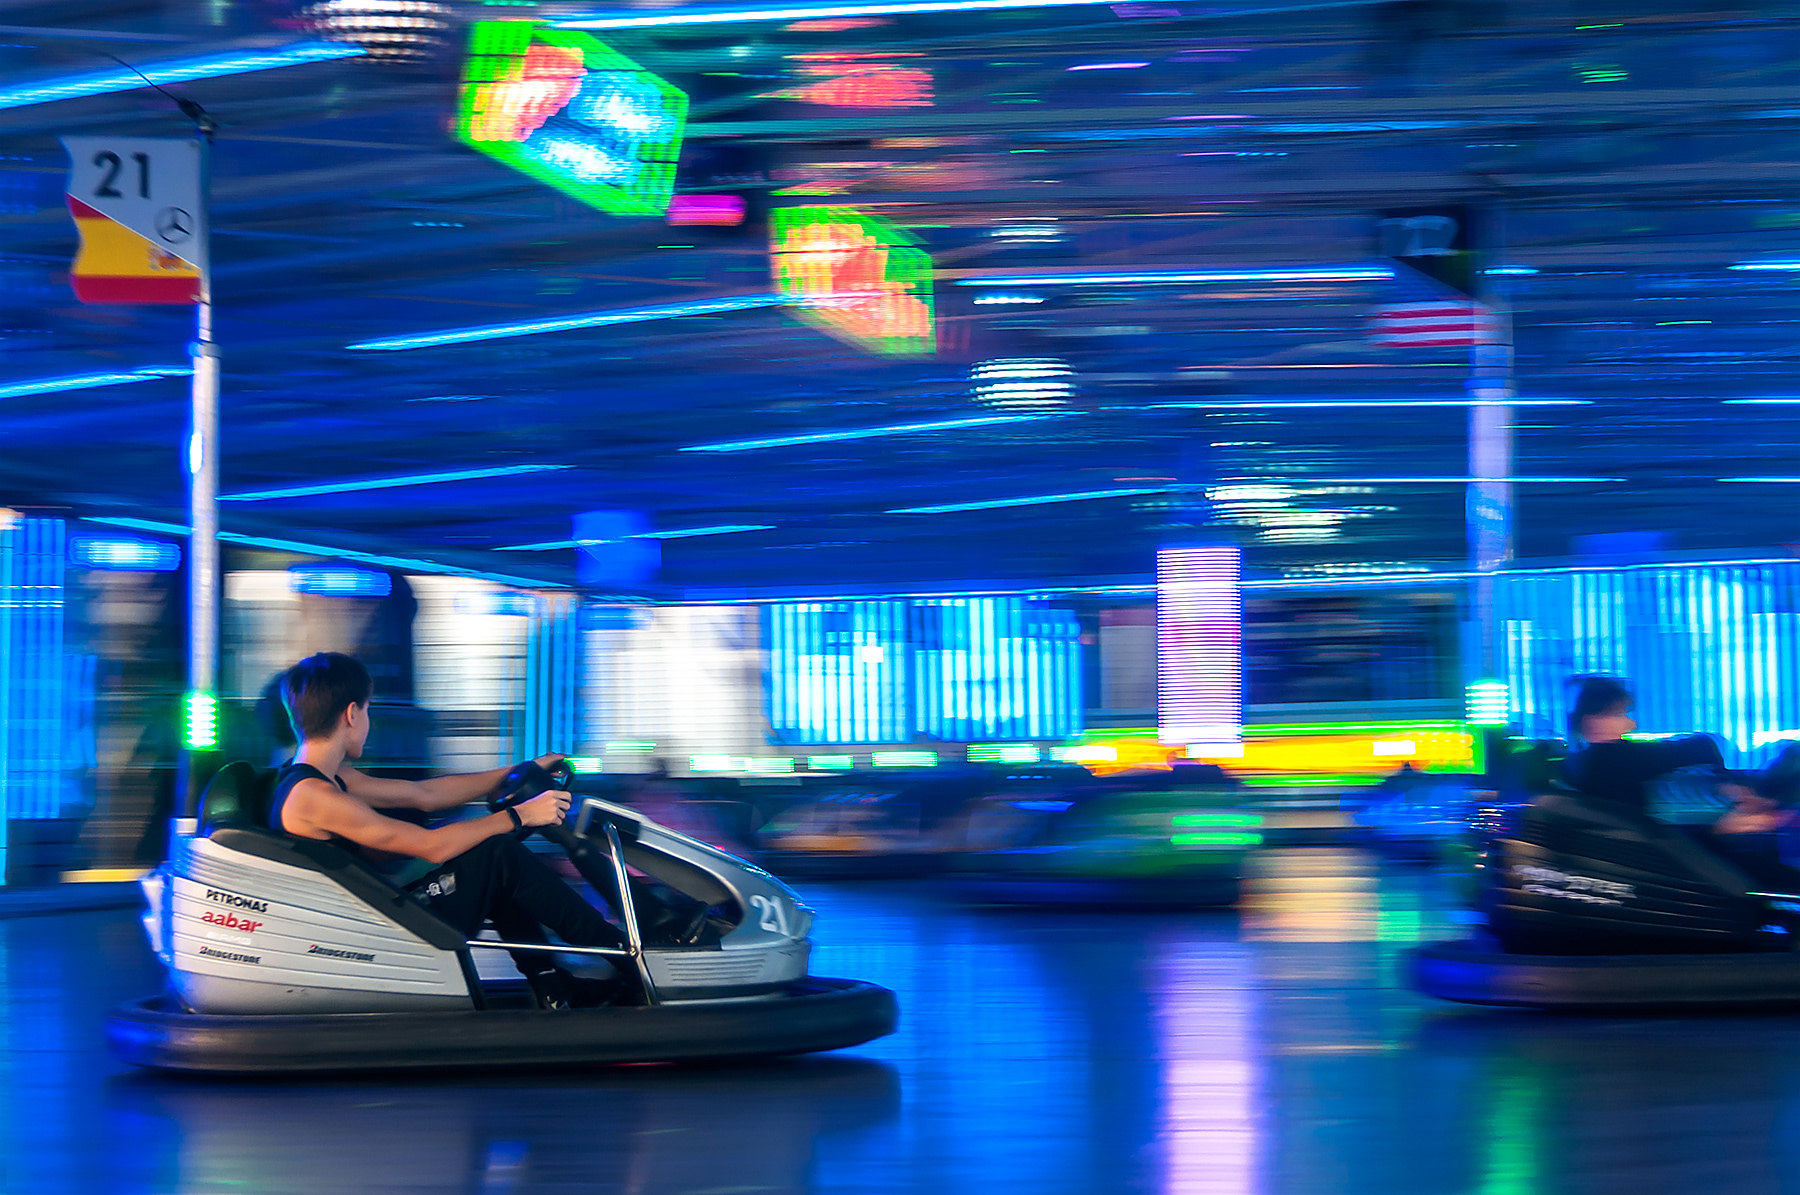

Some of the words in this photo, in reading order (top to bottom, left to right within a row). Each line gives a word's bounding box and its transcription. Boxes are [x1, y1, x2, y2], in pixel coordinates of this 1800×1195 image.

[92, 150, 151, 199] 21
[206, 889, 269, 913] PETRONAS
[201, 911, 263, 933] aabar
[749, 895, 790, 937] 21
[199, 946, 261, 964] BRIDGESTONE
[307, 944, 376, 962] BRIDGESTONE
